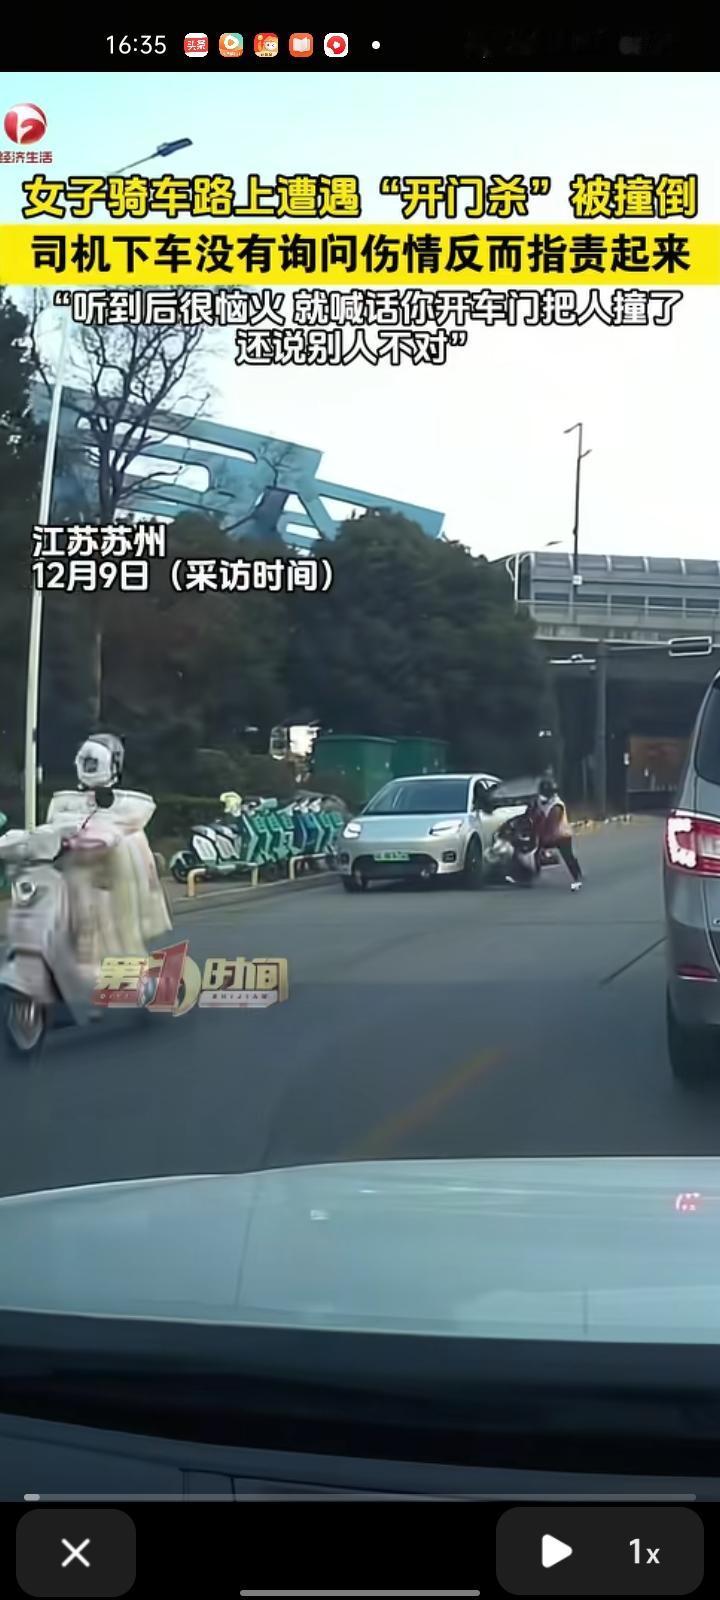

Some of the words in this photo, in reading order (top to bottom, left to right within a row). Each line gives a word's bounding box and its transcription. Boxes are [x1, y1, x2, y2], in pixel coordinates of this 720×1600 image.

[106, 35, 166, 54] 16:35
[186, 40, 206, 51] 头条
[629, 1538, 661, 1564] 1x
